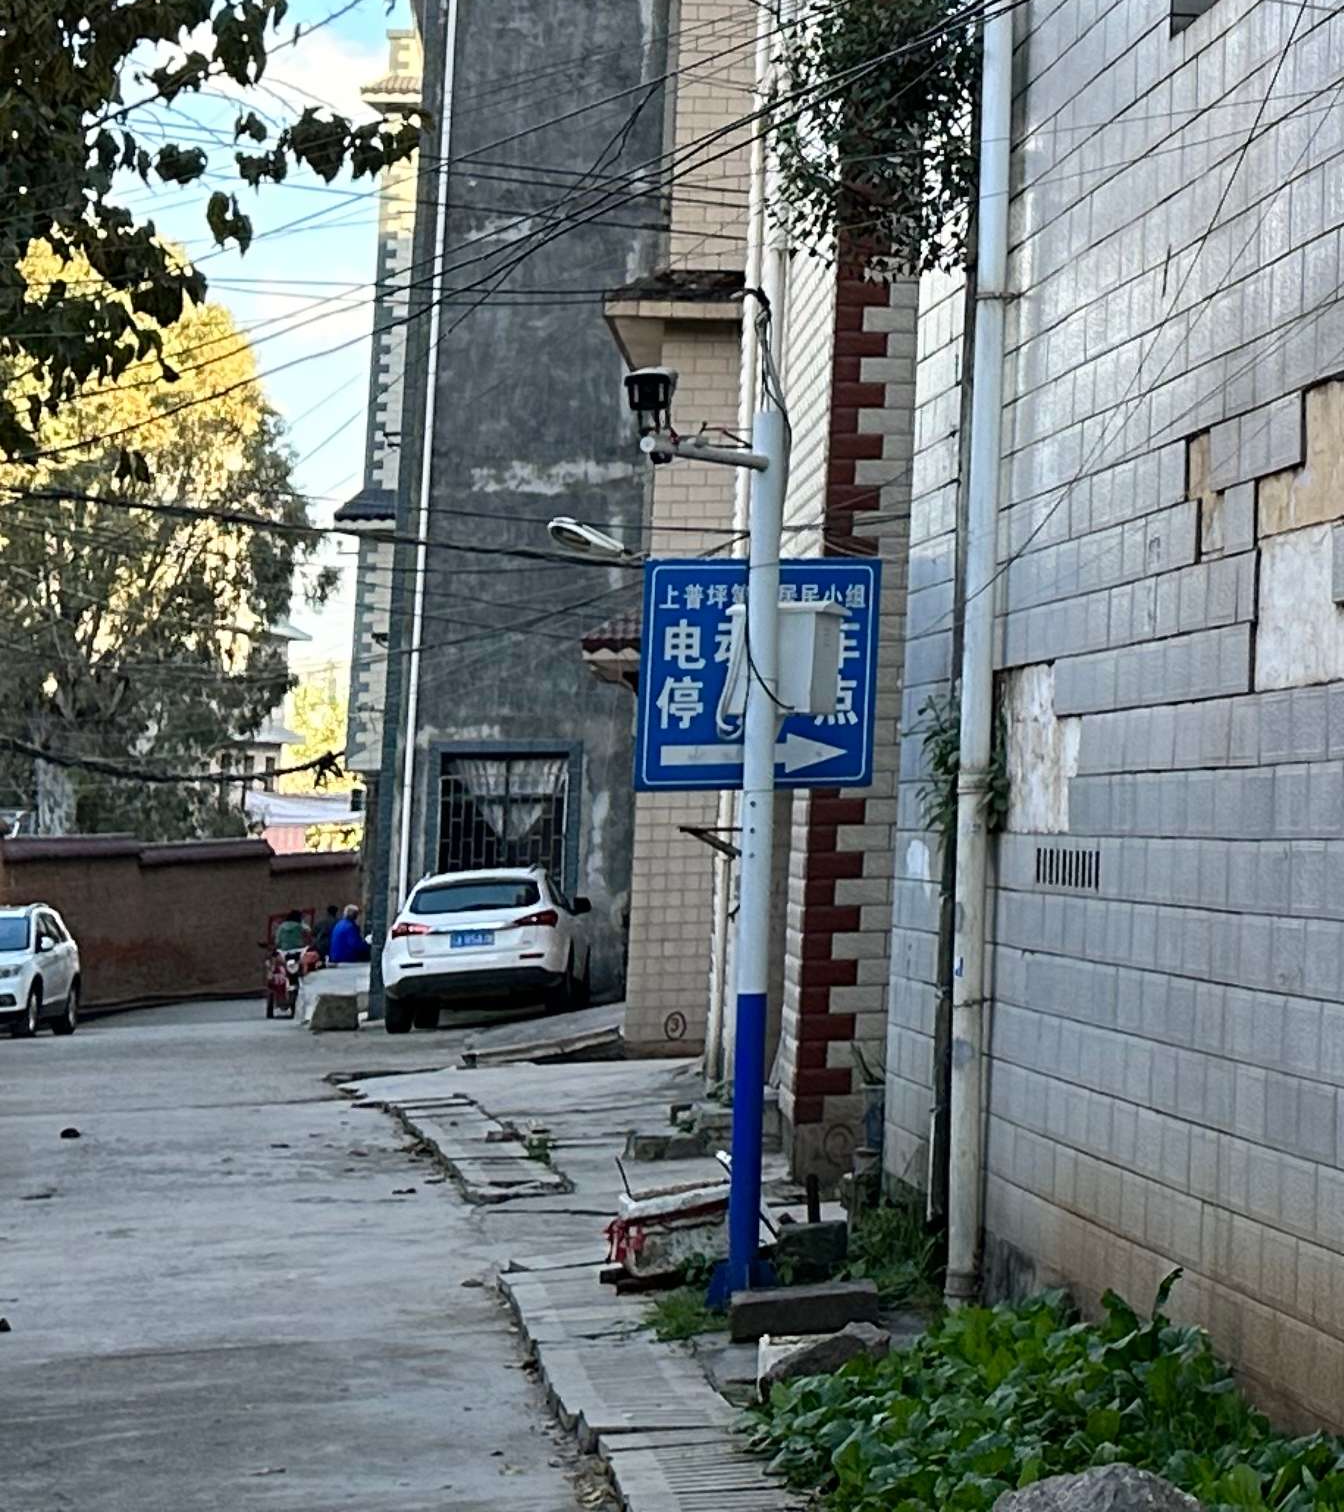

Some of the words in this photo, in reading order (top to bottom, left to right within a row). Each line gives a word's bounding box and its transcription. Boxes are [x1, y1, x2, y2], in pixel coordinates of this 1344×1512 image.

[658, 583, 867, 610] 上普坪第居民小组
